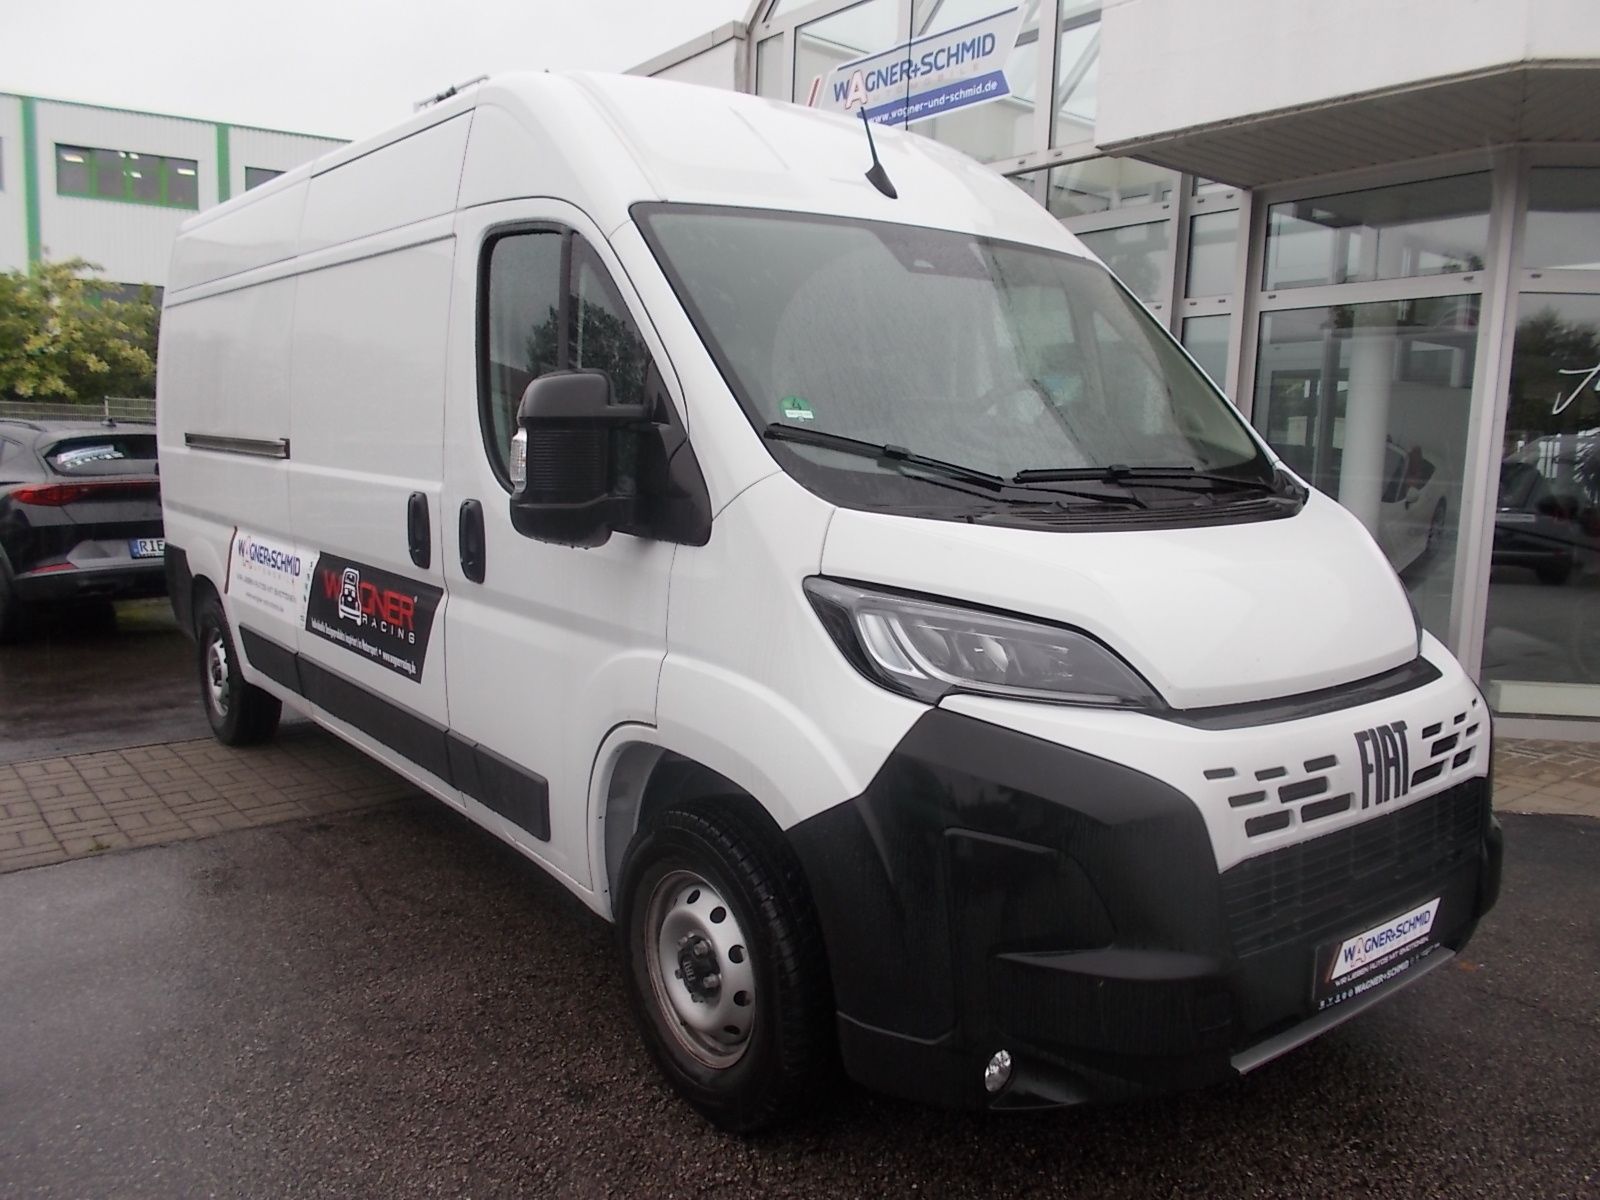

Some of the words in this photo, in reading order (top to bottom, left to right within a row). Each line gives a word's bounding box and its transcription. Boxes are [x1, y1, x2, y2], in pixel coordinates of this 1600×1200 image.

[834, 33, 995, 109] WAGNER+SCHMID
[361, 613, 415, 644] RACING
[1353, 720, 1409, 810] FIAT
[1344, 910, 1431, 968] WAGNER+SCHMID
